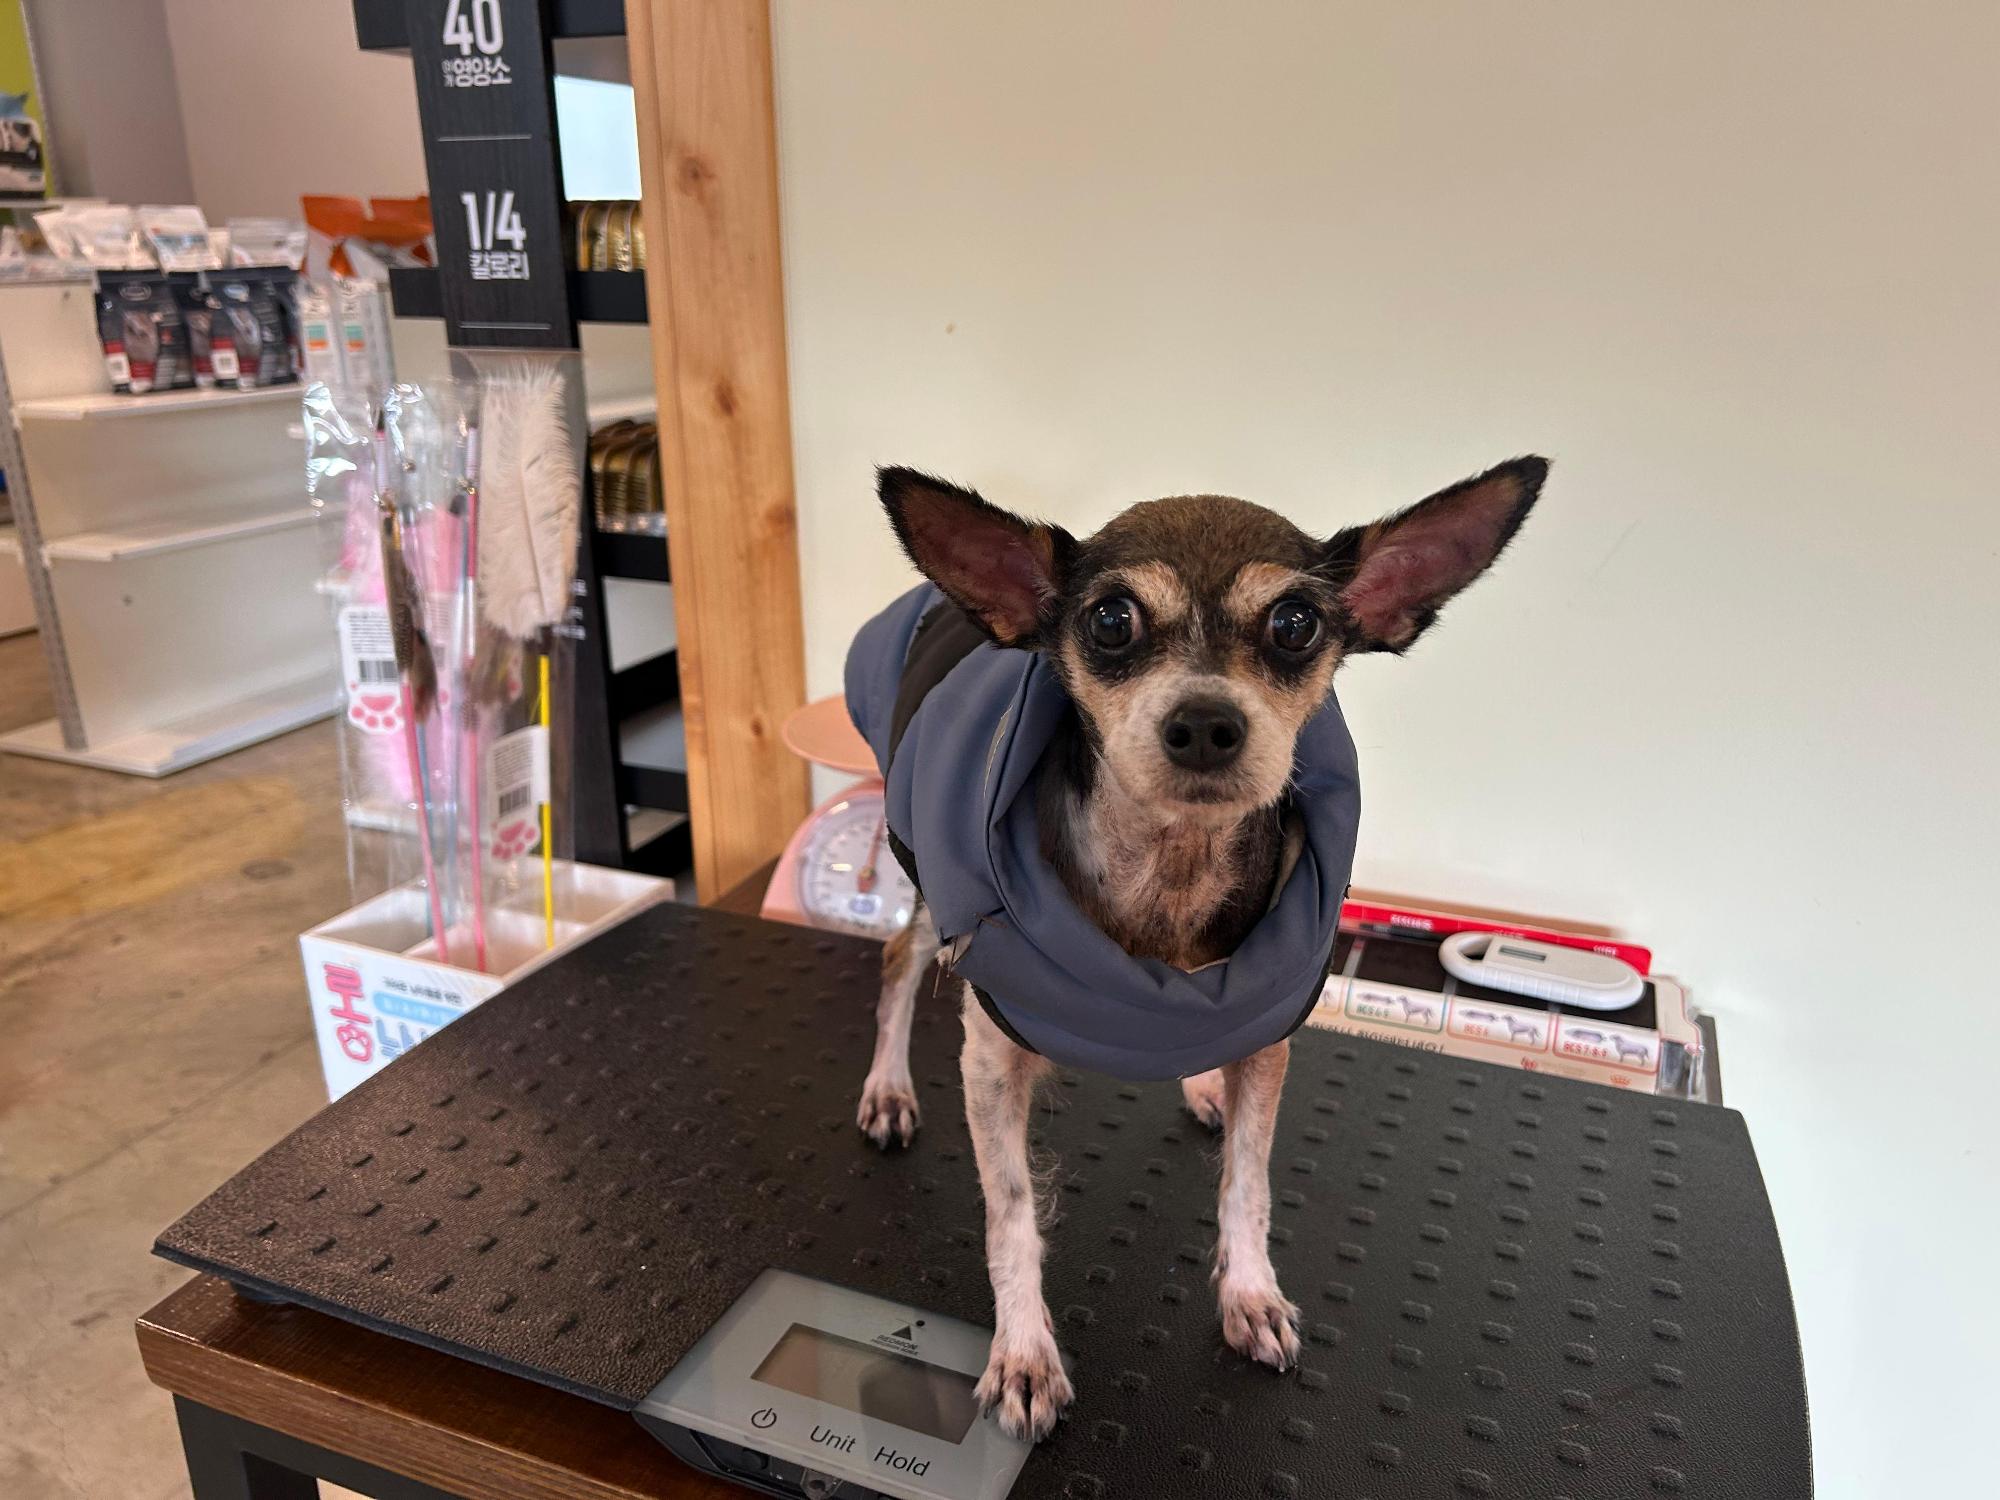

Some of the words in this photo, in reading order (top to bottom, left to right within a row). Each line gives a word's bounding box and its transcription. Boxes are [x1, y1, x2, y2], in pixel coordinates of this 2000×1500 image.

[443, 0, 503, 55] 40
[453, 56, 512, 88] 영양소
[461, 190, 527, 251] 1/4
[468, 251, 530, 280] 칼로리
[810, 1425, 856, 1453] Unit
[873, 1446, 931, 1477] Hold
